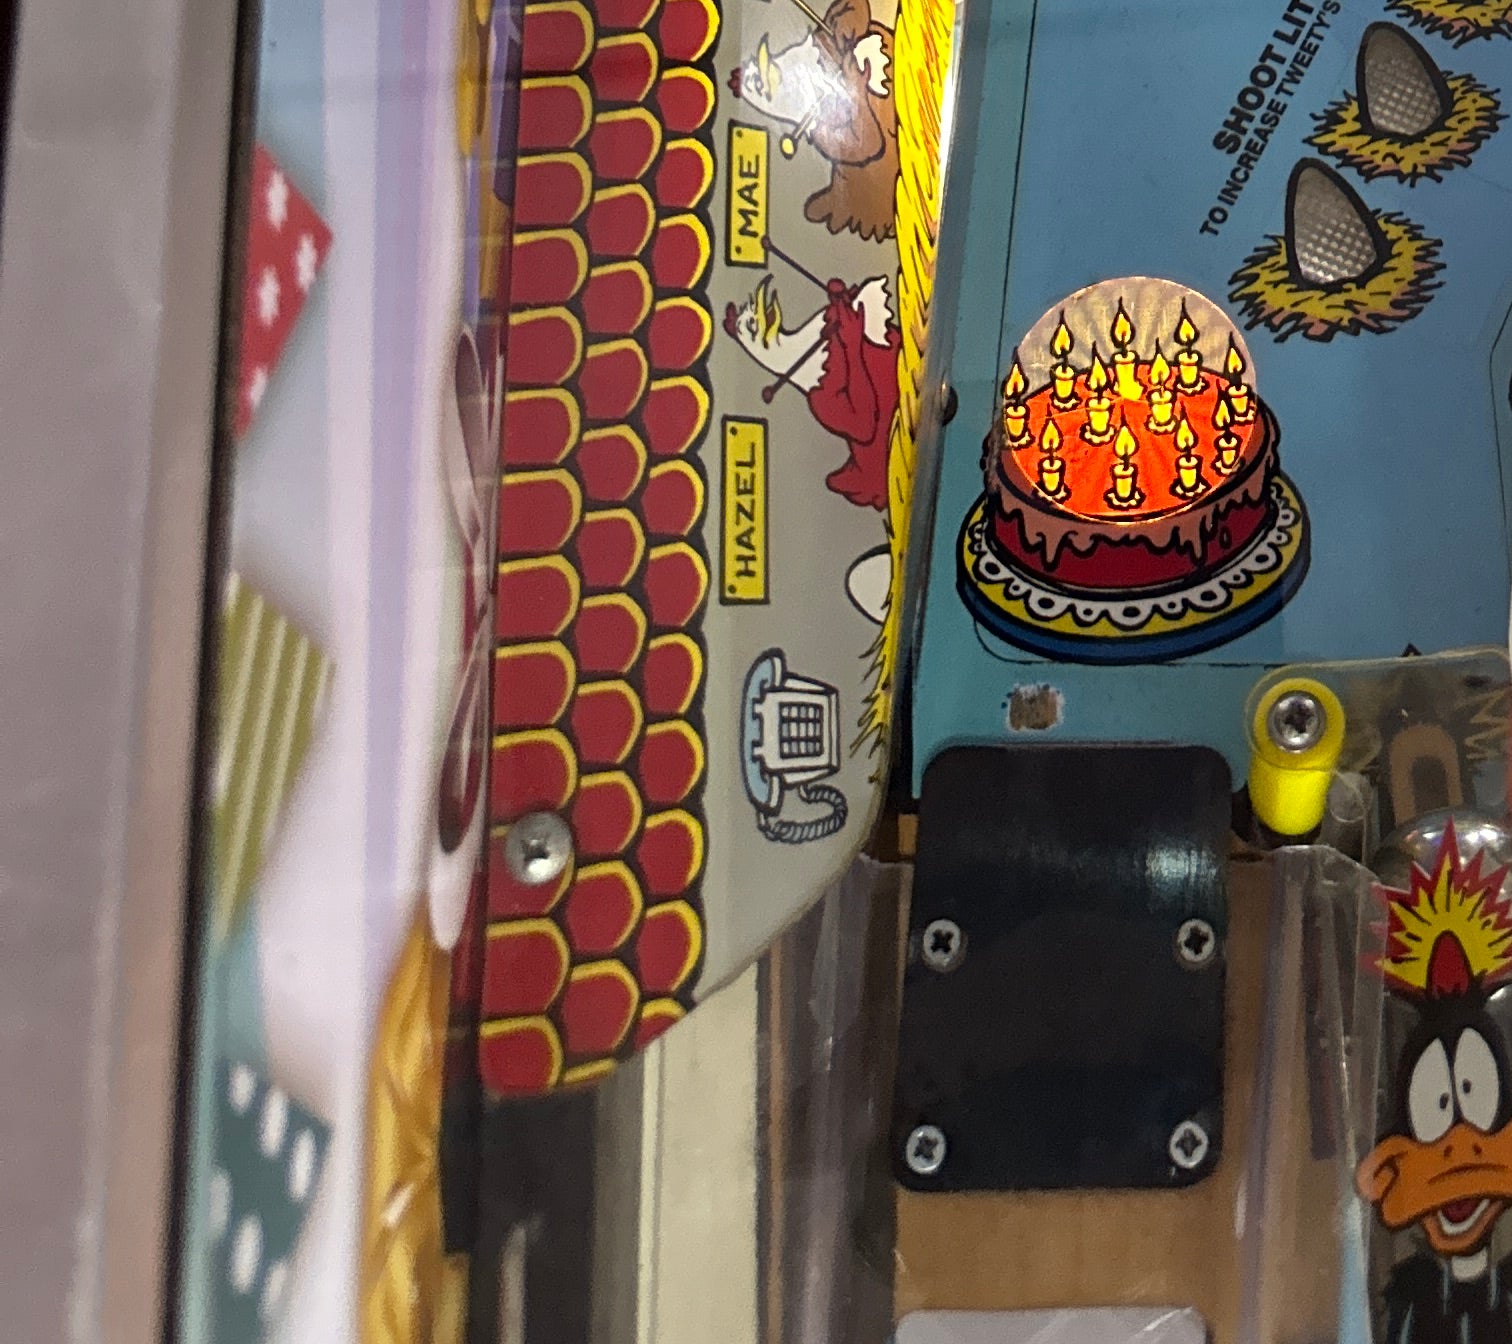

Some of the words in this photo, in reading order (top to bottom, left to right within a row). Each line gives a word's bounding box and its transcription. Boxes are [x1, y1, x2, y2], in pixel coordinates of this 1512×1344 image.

[1200, 205, 1230, 237] TO
[1218, 99, 1288, 207] INCREASE
[1278, 0, 1341, 99] TWEETY'S
[1212, 43, 1287, 155] SHOOT
[738, 153, 761, 238] MAE
[735, 440, 758, 579] HAZEL
